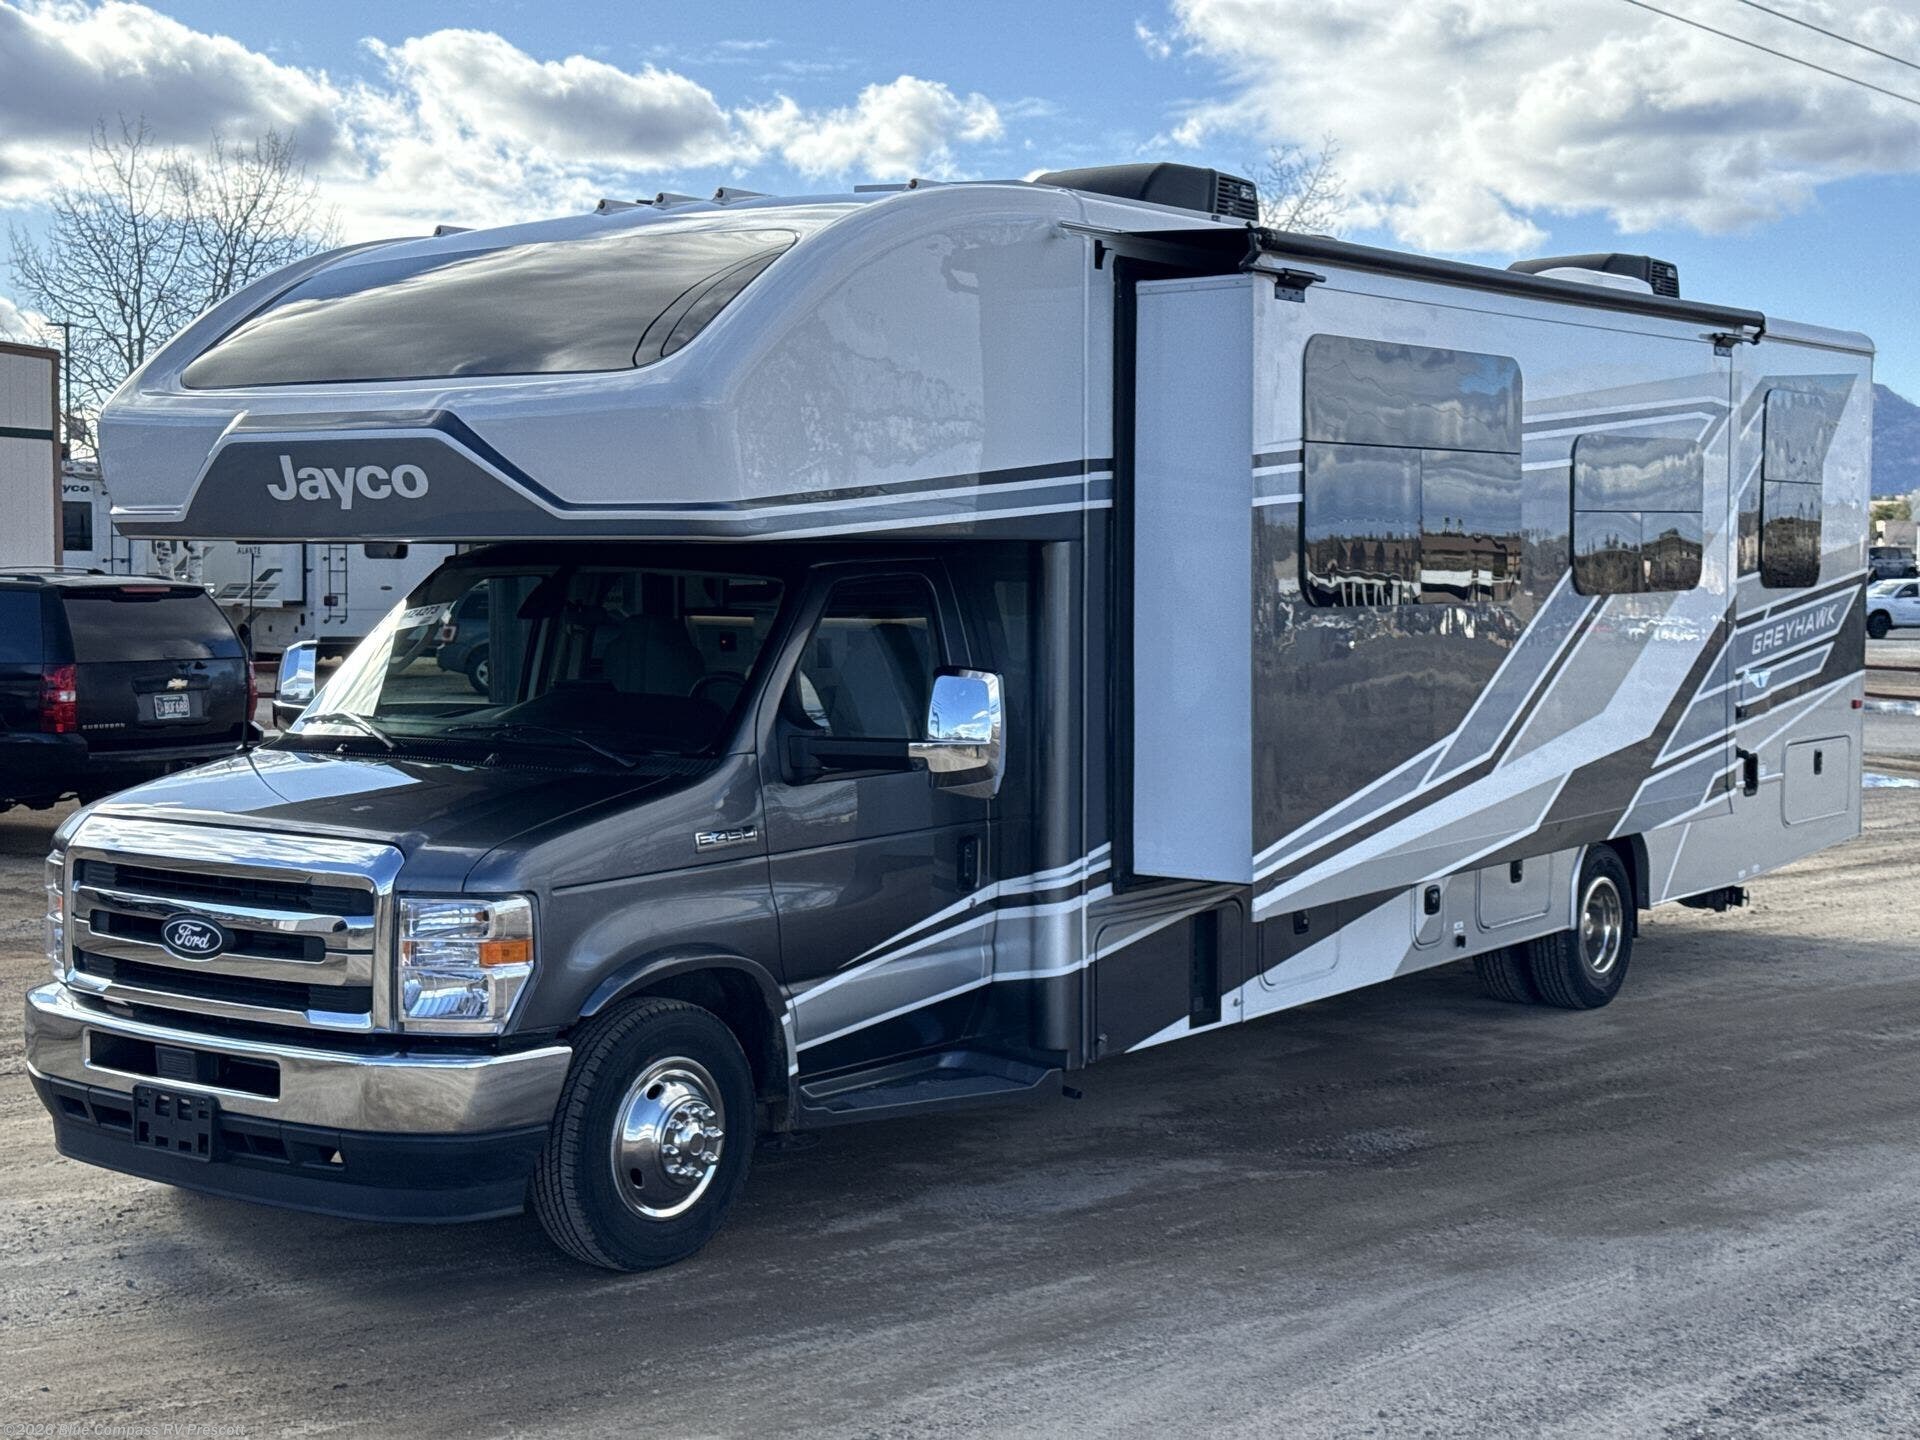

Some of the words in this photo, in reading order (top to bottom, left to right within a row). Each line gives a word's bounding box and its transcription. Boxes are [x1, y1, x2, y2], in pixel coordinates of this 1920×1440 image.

[266, 454, 429, 510] Jayco
[1751, 603, 1838, 656] GREYHAWK
[174, 923, 211, 949] Ford
